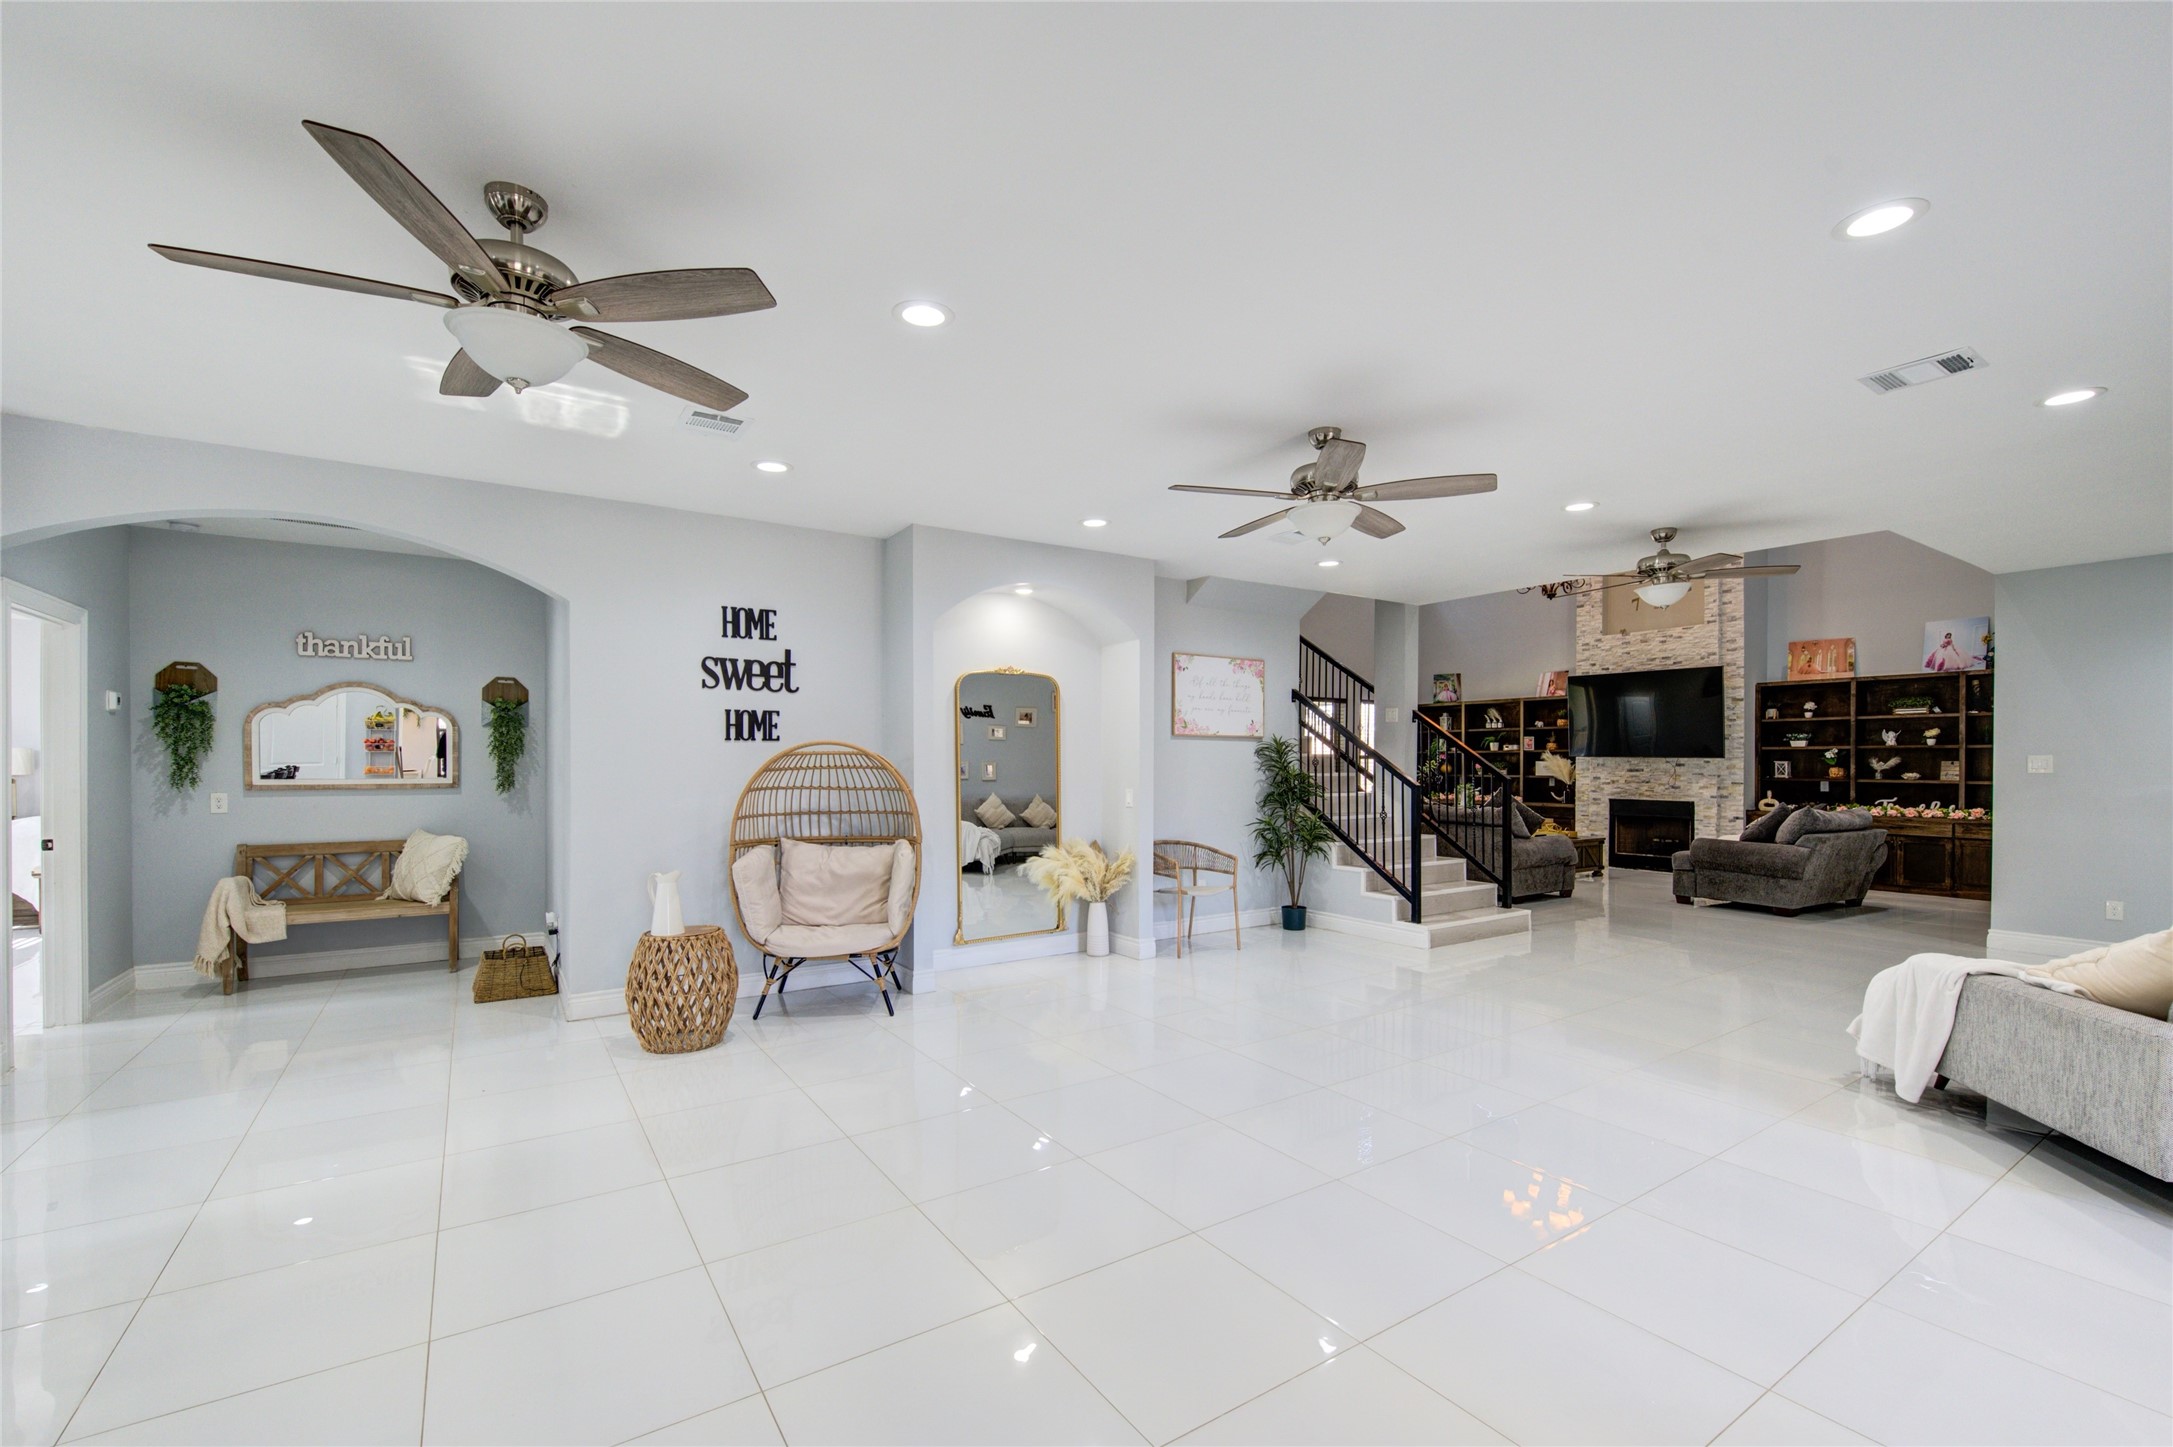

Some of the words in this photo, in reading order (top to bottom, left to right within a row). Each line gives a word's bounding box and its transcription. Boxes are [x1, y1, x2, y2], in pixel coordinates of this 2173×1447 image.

[721, 606, 777, 641] HOME
[295, 631, 413, 661] thankful
[701, 648, 800, 693] sweet
[724, 709, 780, 742] HOME
